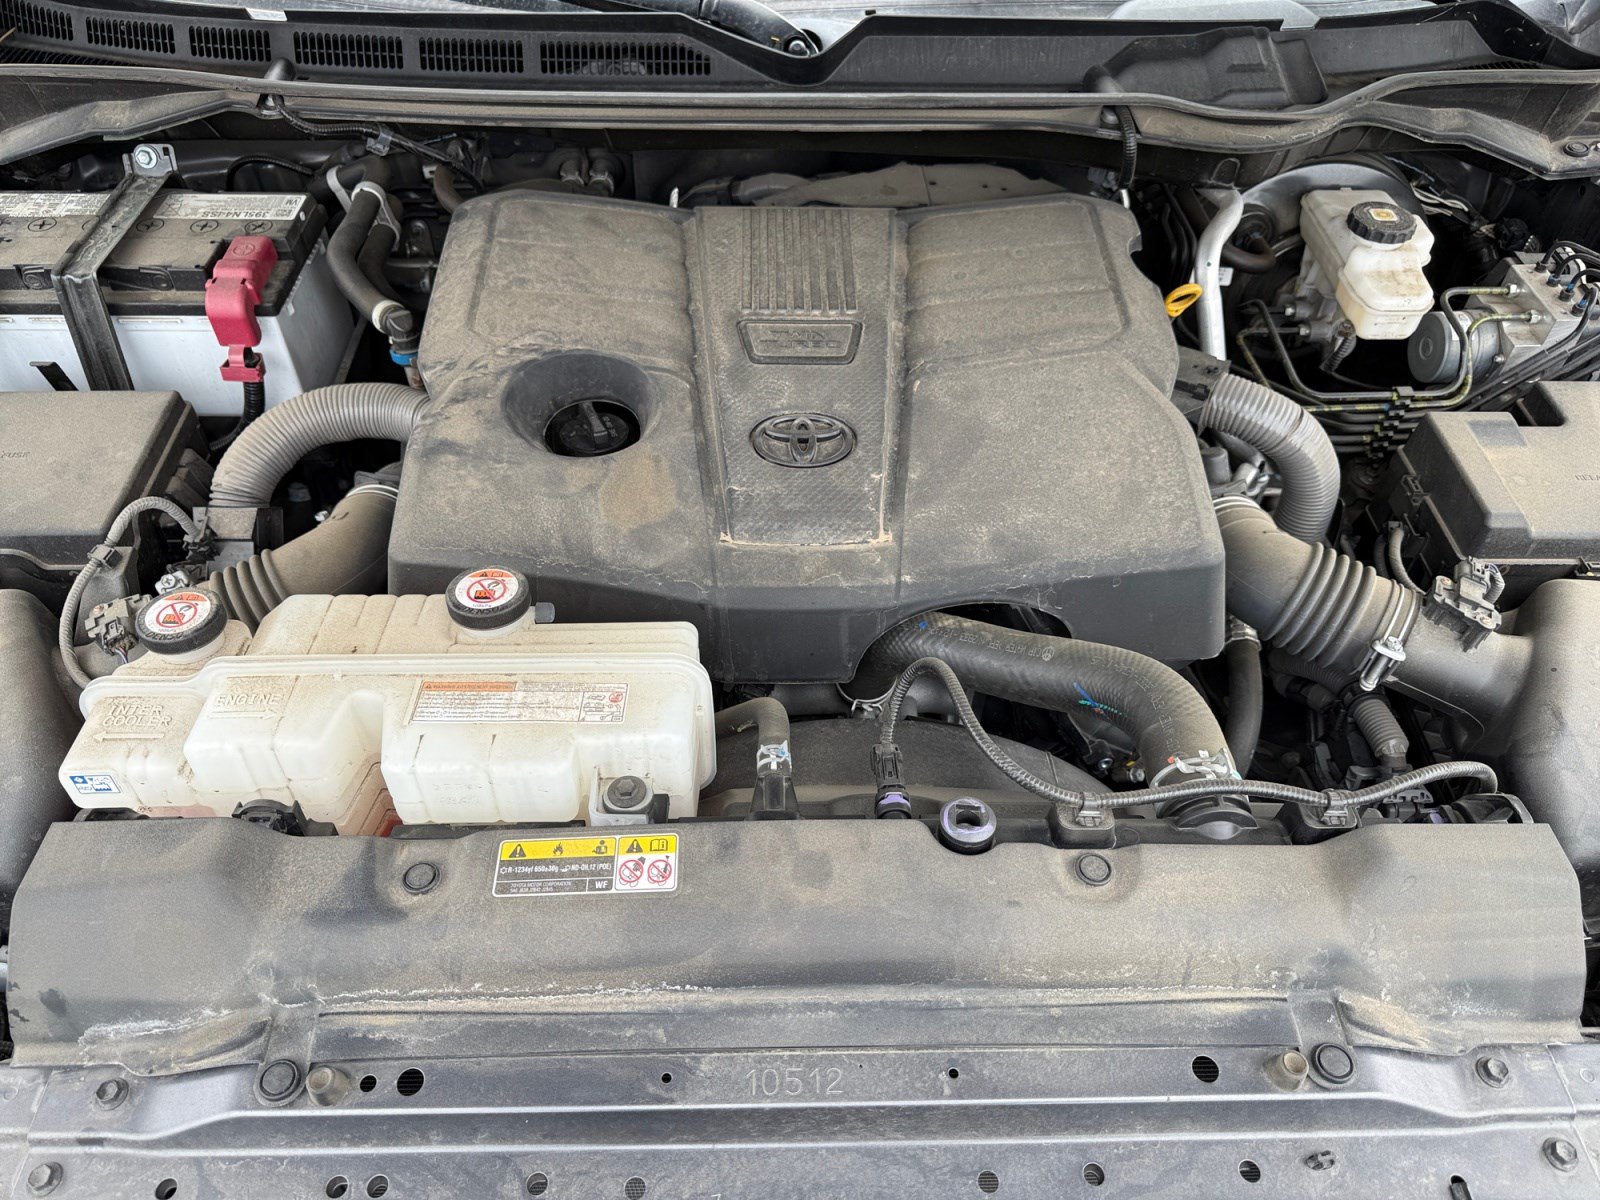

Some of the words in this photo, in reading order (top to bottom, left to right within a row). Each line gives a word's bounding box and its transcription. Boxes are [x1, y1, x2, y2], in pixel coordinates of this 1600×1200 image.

[145, 632, 184, 641] DENSO
[214, 693, 284, 706] ENGINE
[107, 704, 164, 717] INTER
[102, 715, 173, 728] COOLER
[595, 880, 609, 889] WF
[744, 1067, 845, 1097] 10512
